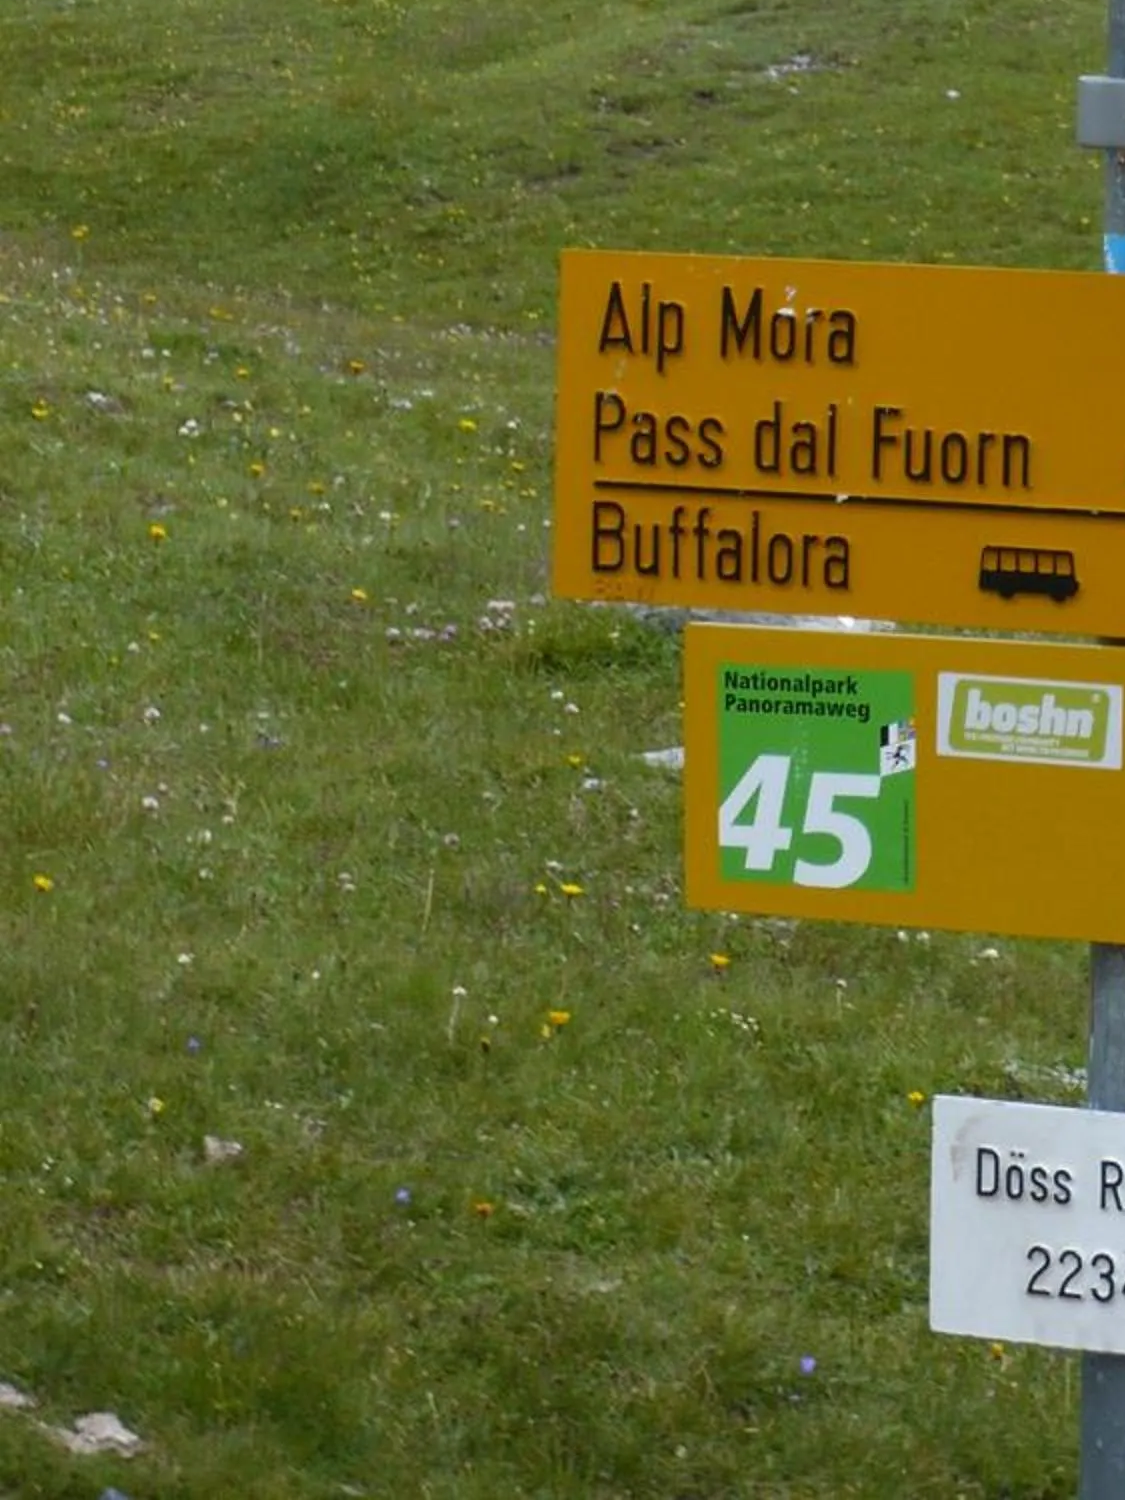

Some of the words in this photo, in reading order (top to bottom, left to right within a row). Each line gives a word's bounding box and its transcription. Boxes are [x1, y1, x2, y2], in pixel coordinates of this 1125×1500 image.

[600, 281, 685, 374] Alp
[720, 286, 857, 365] Mora
[593, 391, 725, 470] Pass
[754, 401, 839, 477] dal
[872, 406, 1032, 488] Fuorn
[591, 501, 851, 591] Buffalora
[724, 671, 859, 699] Nationalpark
[724, 694, 870, 723] Panoramaweg
[718, 754, 882, 889] 45
[976, 1148, 1073, 1204] Döss
